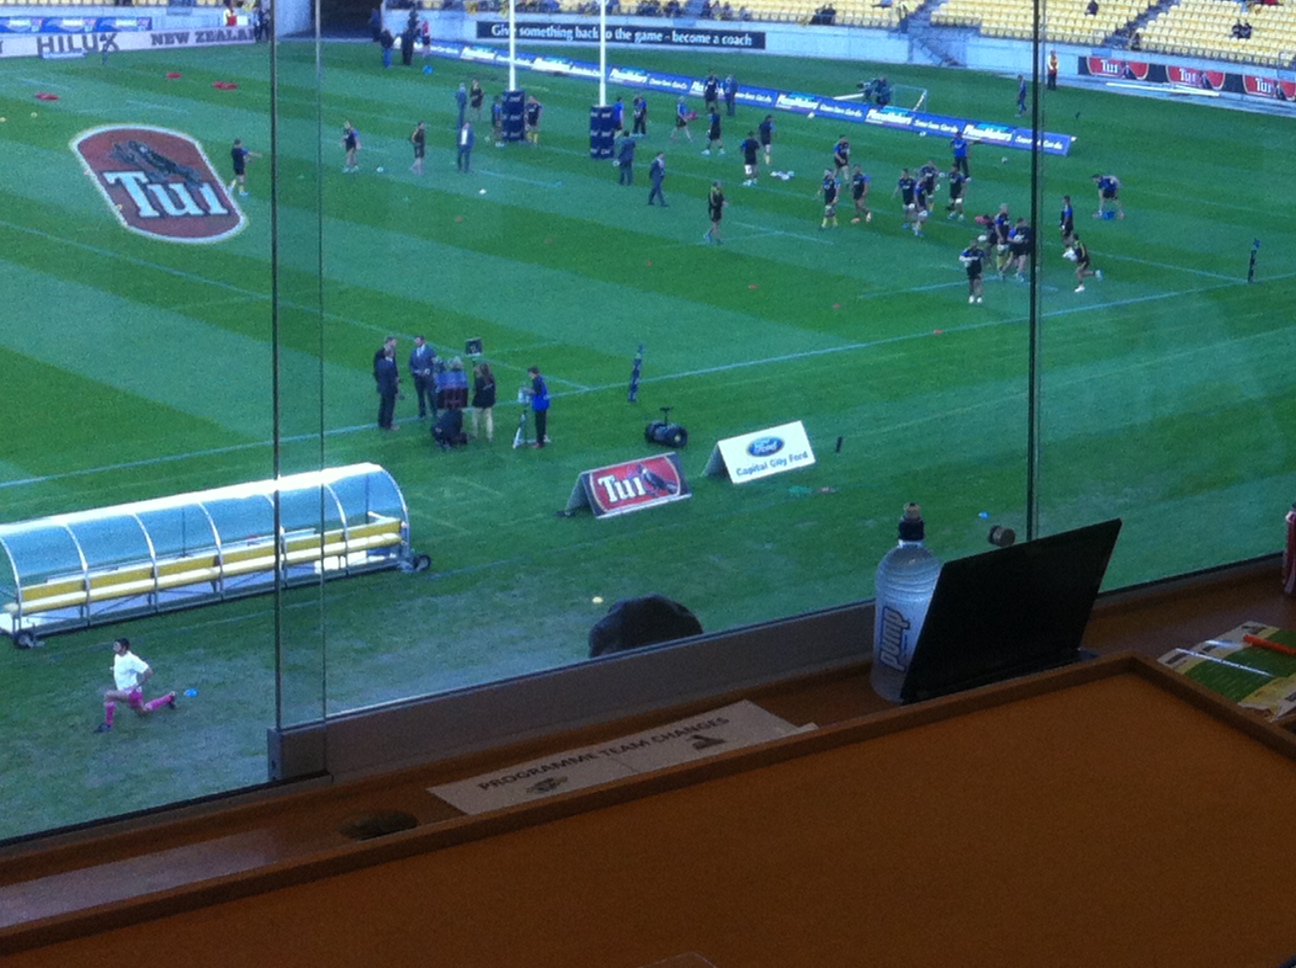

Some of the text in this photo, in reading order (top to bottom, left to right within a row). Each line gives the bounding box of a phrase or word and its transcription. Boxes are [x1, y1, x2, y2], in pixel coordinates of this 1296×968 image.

[37, 32, 119, 54] HILUX
[151, 28, 255, 46] NEW ZEALA
[491, 24, 515, 37] Giv
[519, 25, 573, 42] something
[575, 26, 599, 39] back
[615, 27, 632, 40] the
[634, 32, 663, 44] game
[672, 30, 711, 44] become
[713, 35, 720, 45] a
[721, 32, 752, 47] coach
[103, 170, 230, 218] Tui
[736, 462, 768, 476] Capital
[789, 450, 809, 462] Ford
[597, 475, 646, 503] Tui
[879, 605, 911, 673] pump
[477, 716, 730, 790] PROGRAMME TEAM CHANGES
